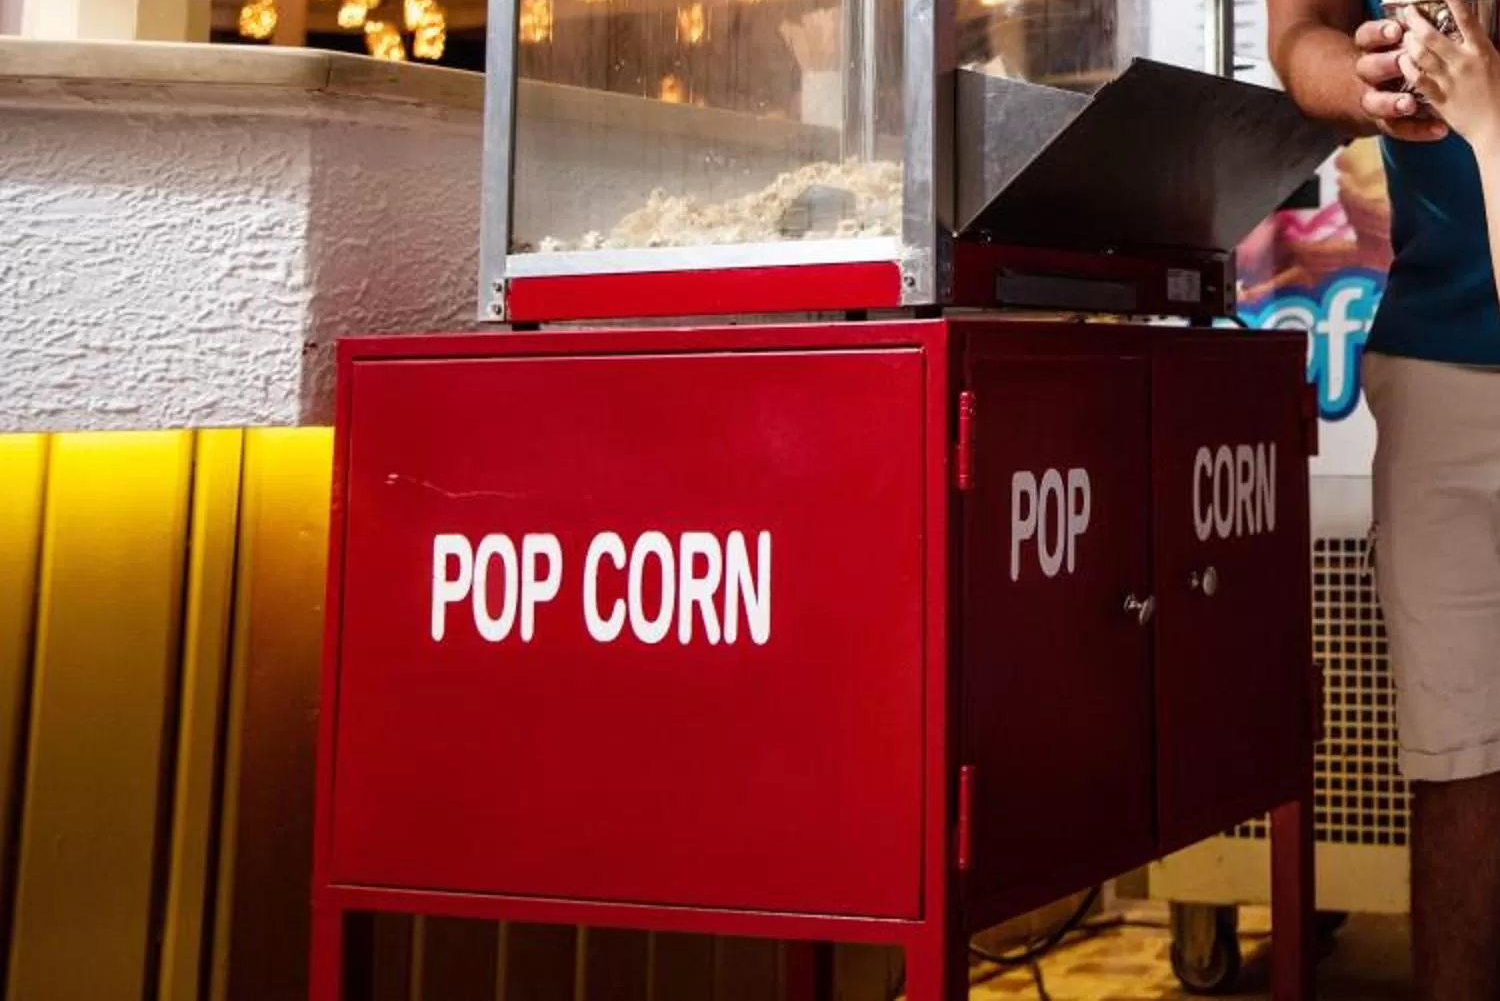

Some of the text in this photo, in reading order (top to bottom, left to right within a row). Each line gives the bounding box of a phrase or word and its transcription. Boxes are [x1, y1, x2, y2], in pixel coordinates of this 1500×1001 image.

[1010, 443, 1276, 581] POP CORN
[431, 530, 771, 645] POP CORN
